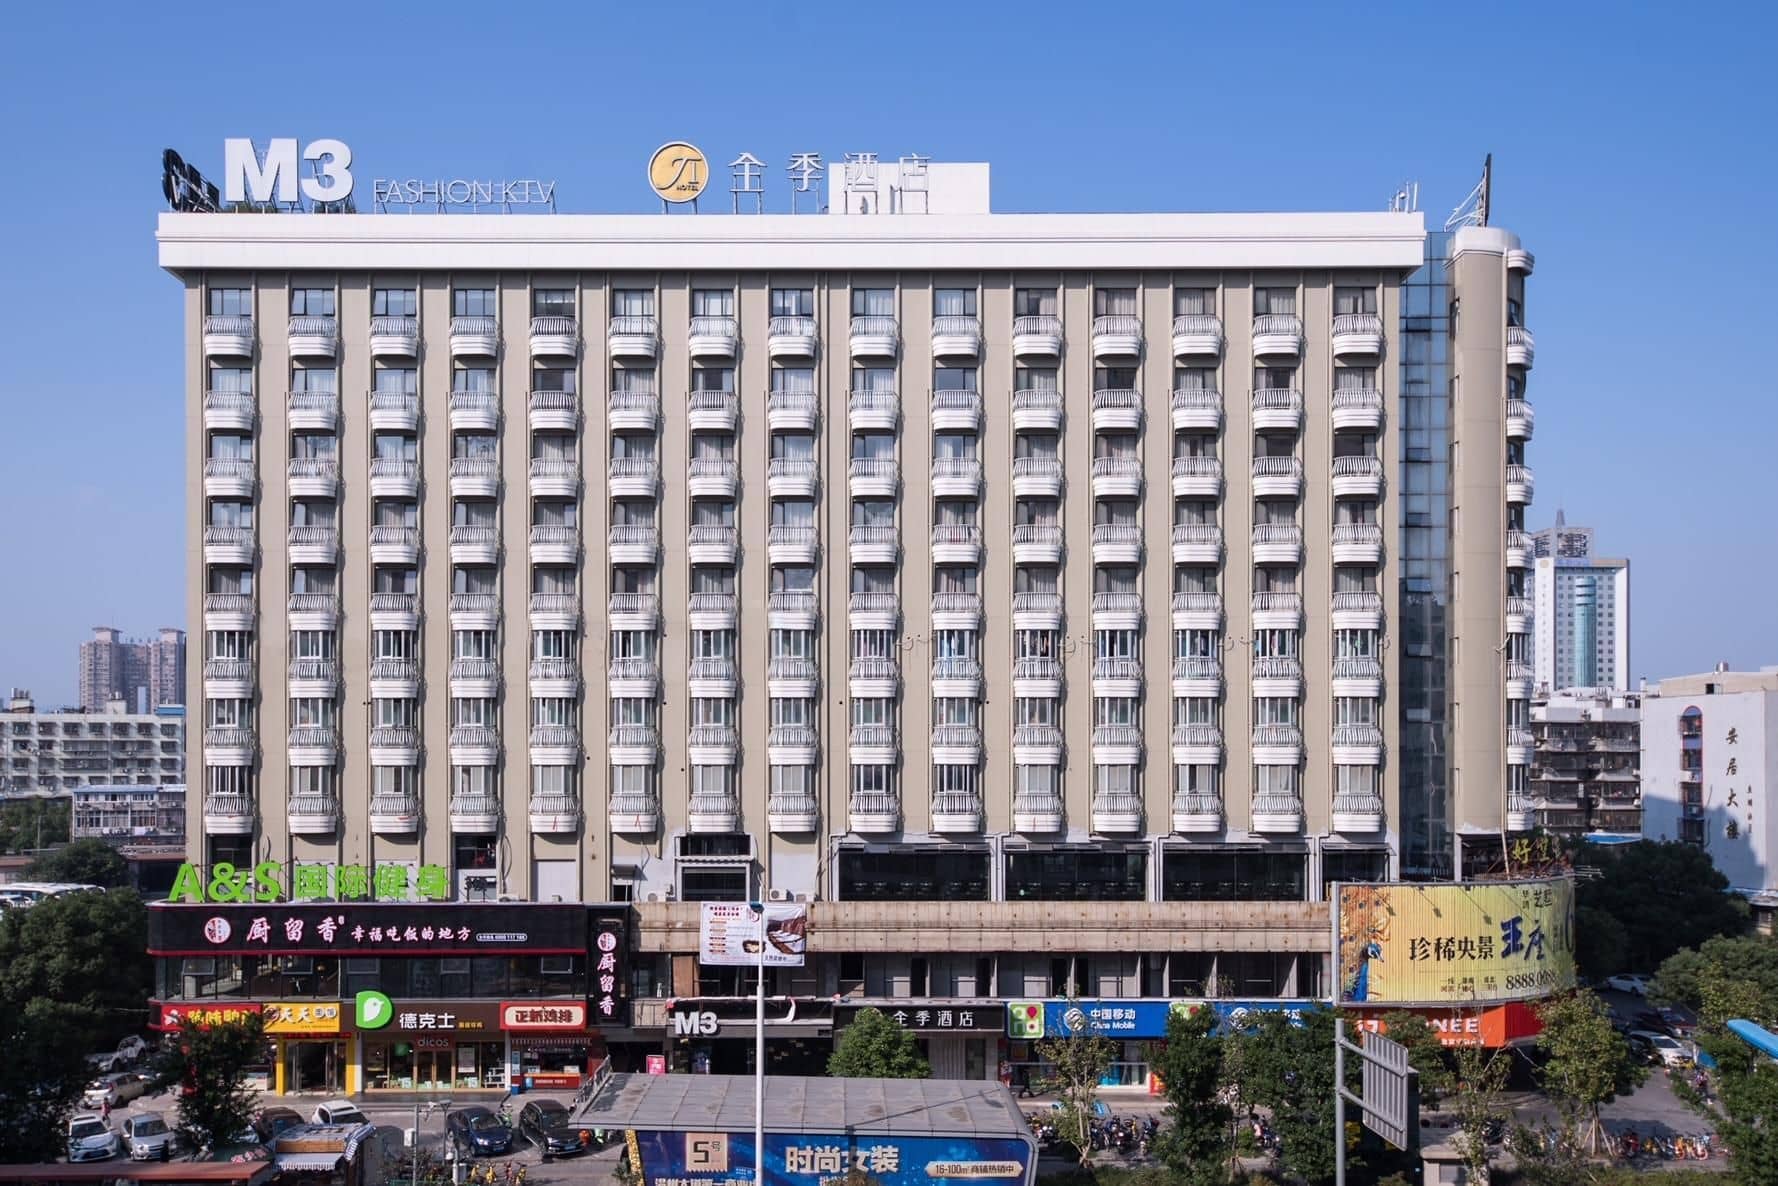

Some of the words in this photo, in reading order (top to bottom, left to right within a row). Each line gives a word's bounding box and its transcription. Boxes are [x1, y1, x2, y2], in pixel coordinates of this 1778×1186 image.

[225, 138, 353, 202] M3
[728, 152, 931, 193] 全季酒店
[374, 180, 494, 203] FASHION
[503, 180, 555, 203] KTV
[168, 862, 282, 902] A&S
[295, 864, 449, 899] 国际健身
[246, 916, 338, 943] 厨留香
[351, 926, 472, 942] 幸福吃饭的地方
[1409, 935, 1495, 961] 珍稀央景
[597, 952, 617, 1017] 厨留香
[399, 1012, 456, 1029] 德克士
[515, 1009, 574, 1024] 正新鸡排
[675, 1011, 718, 1035] M3
[893, 1010, 974, 1027] 全季酒店
[1090, 1008, 1136, 1021] 中国移动
[1112, 1021, 1136, 1030] Mobile
[417, 1038, 449, 1048] dicos
[785, 1145, 899, 1173] 时尚女装
